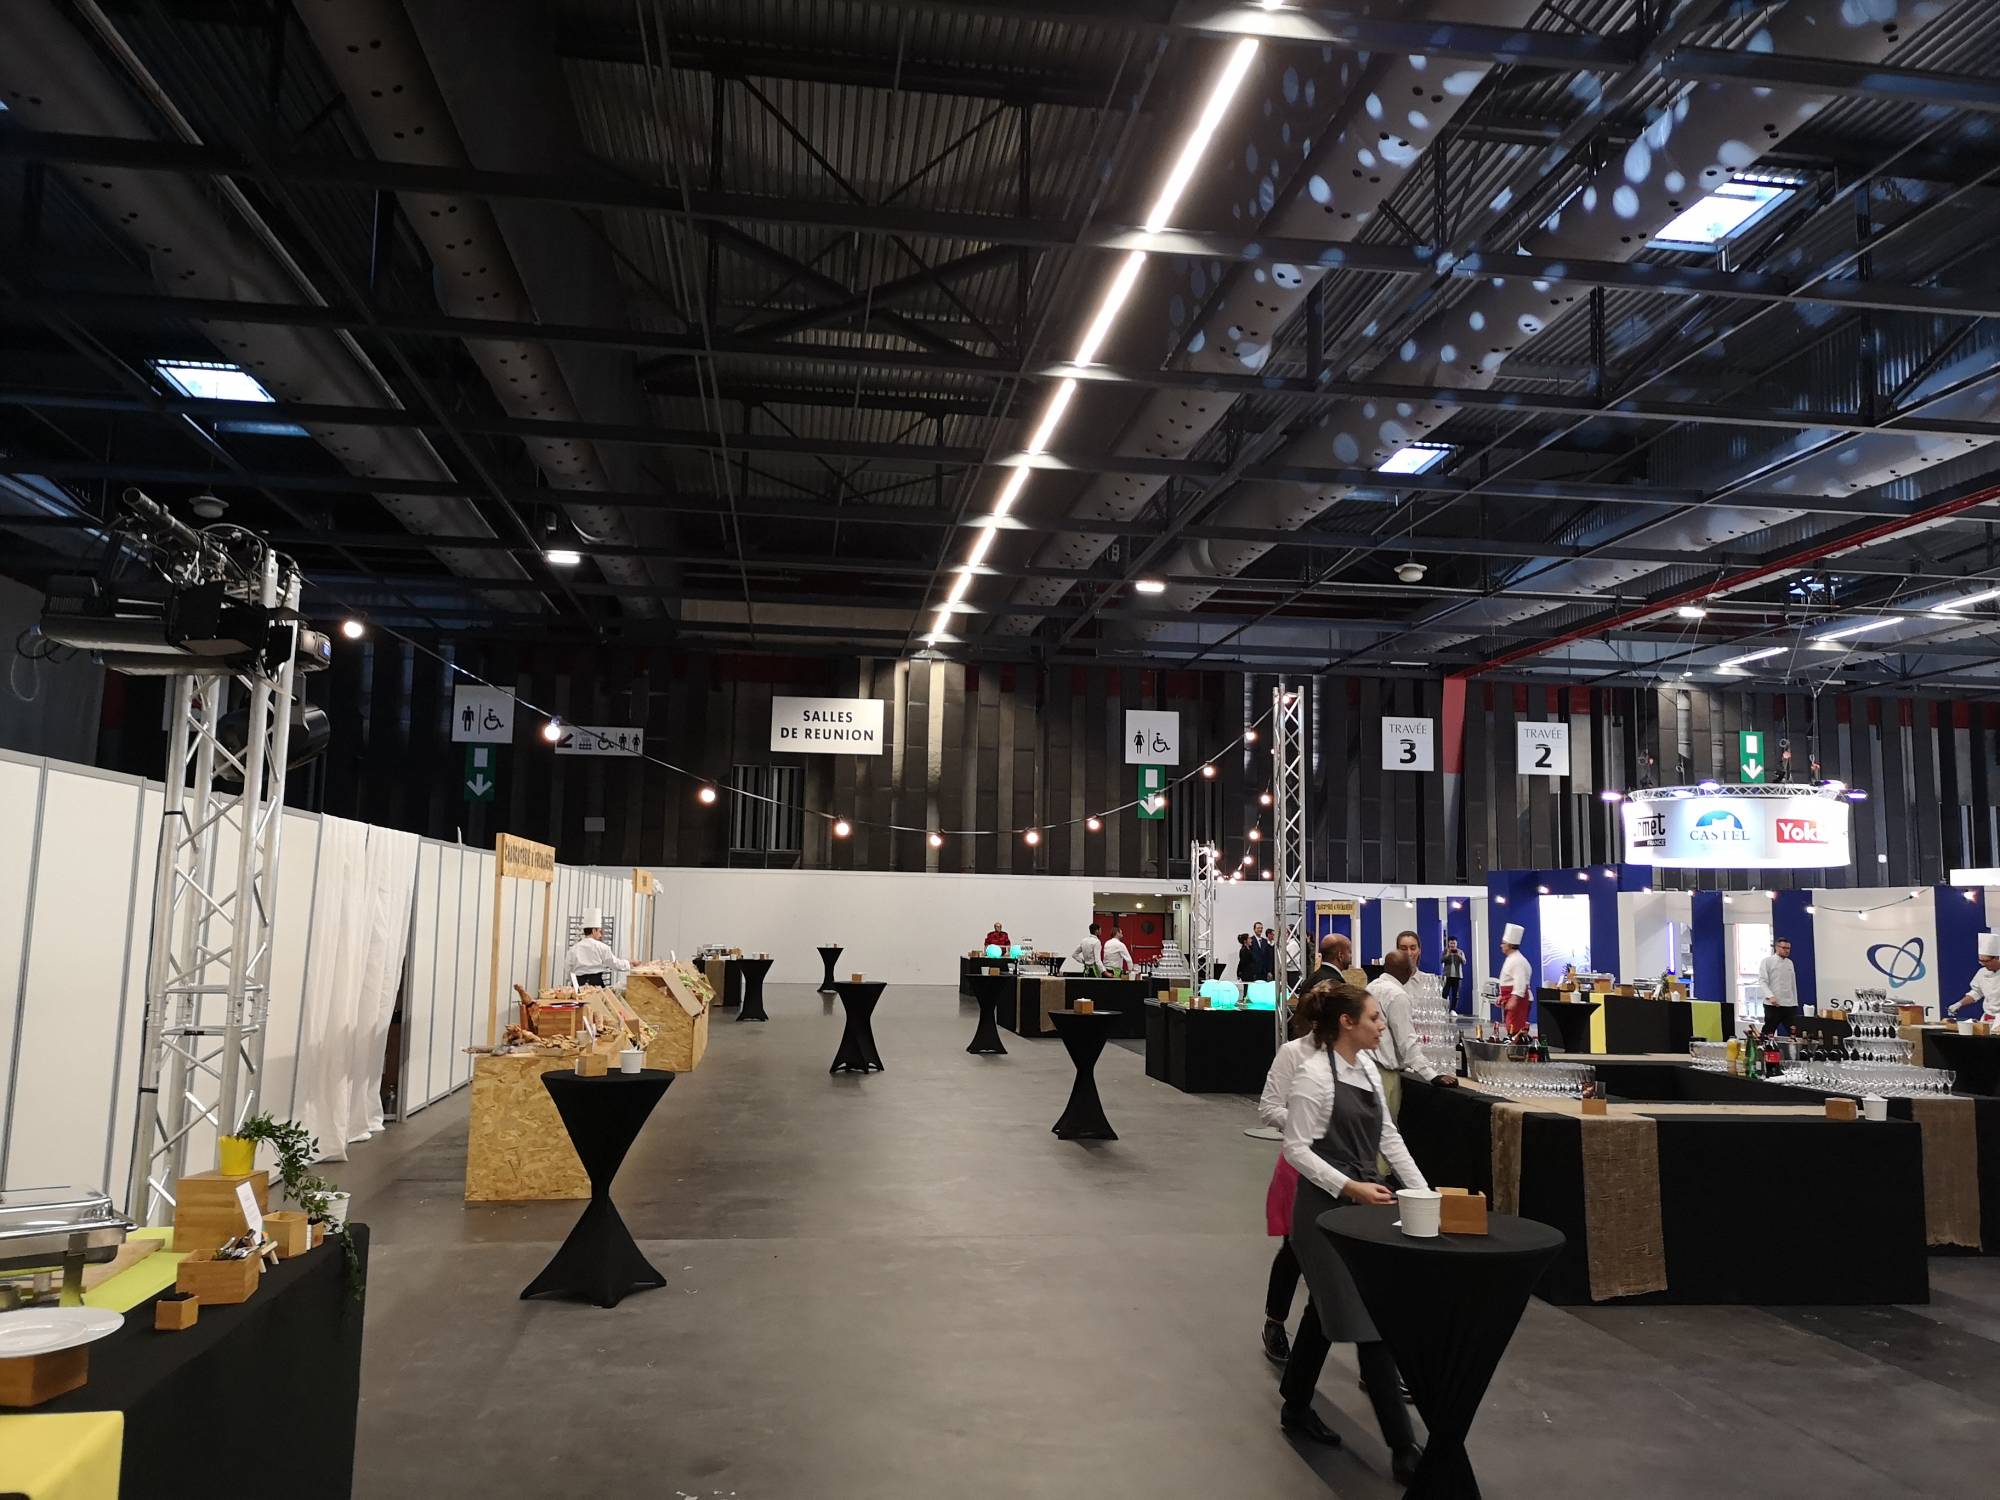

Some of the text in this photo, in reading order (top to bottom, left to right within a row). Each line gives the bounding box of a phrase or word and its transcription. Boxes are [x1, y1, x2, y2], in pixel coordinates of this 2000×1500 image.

[803, 710, 853, 723] SALLES
[780, 727, 874, 741] DE REUNION
[1389, 722, 1427, 735] TRAVÉE
[1524, 727, 1562, 739] TRAVÉE
[1399, 739, 1417, 764] 3
[1535, 743, 1552, 768] 2
[1689, 830, 1750, 841] CASTEL
